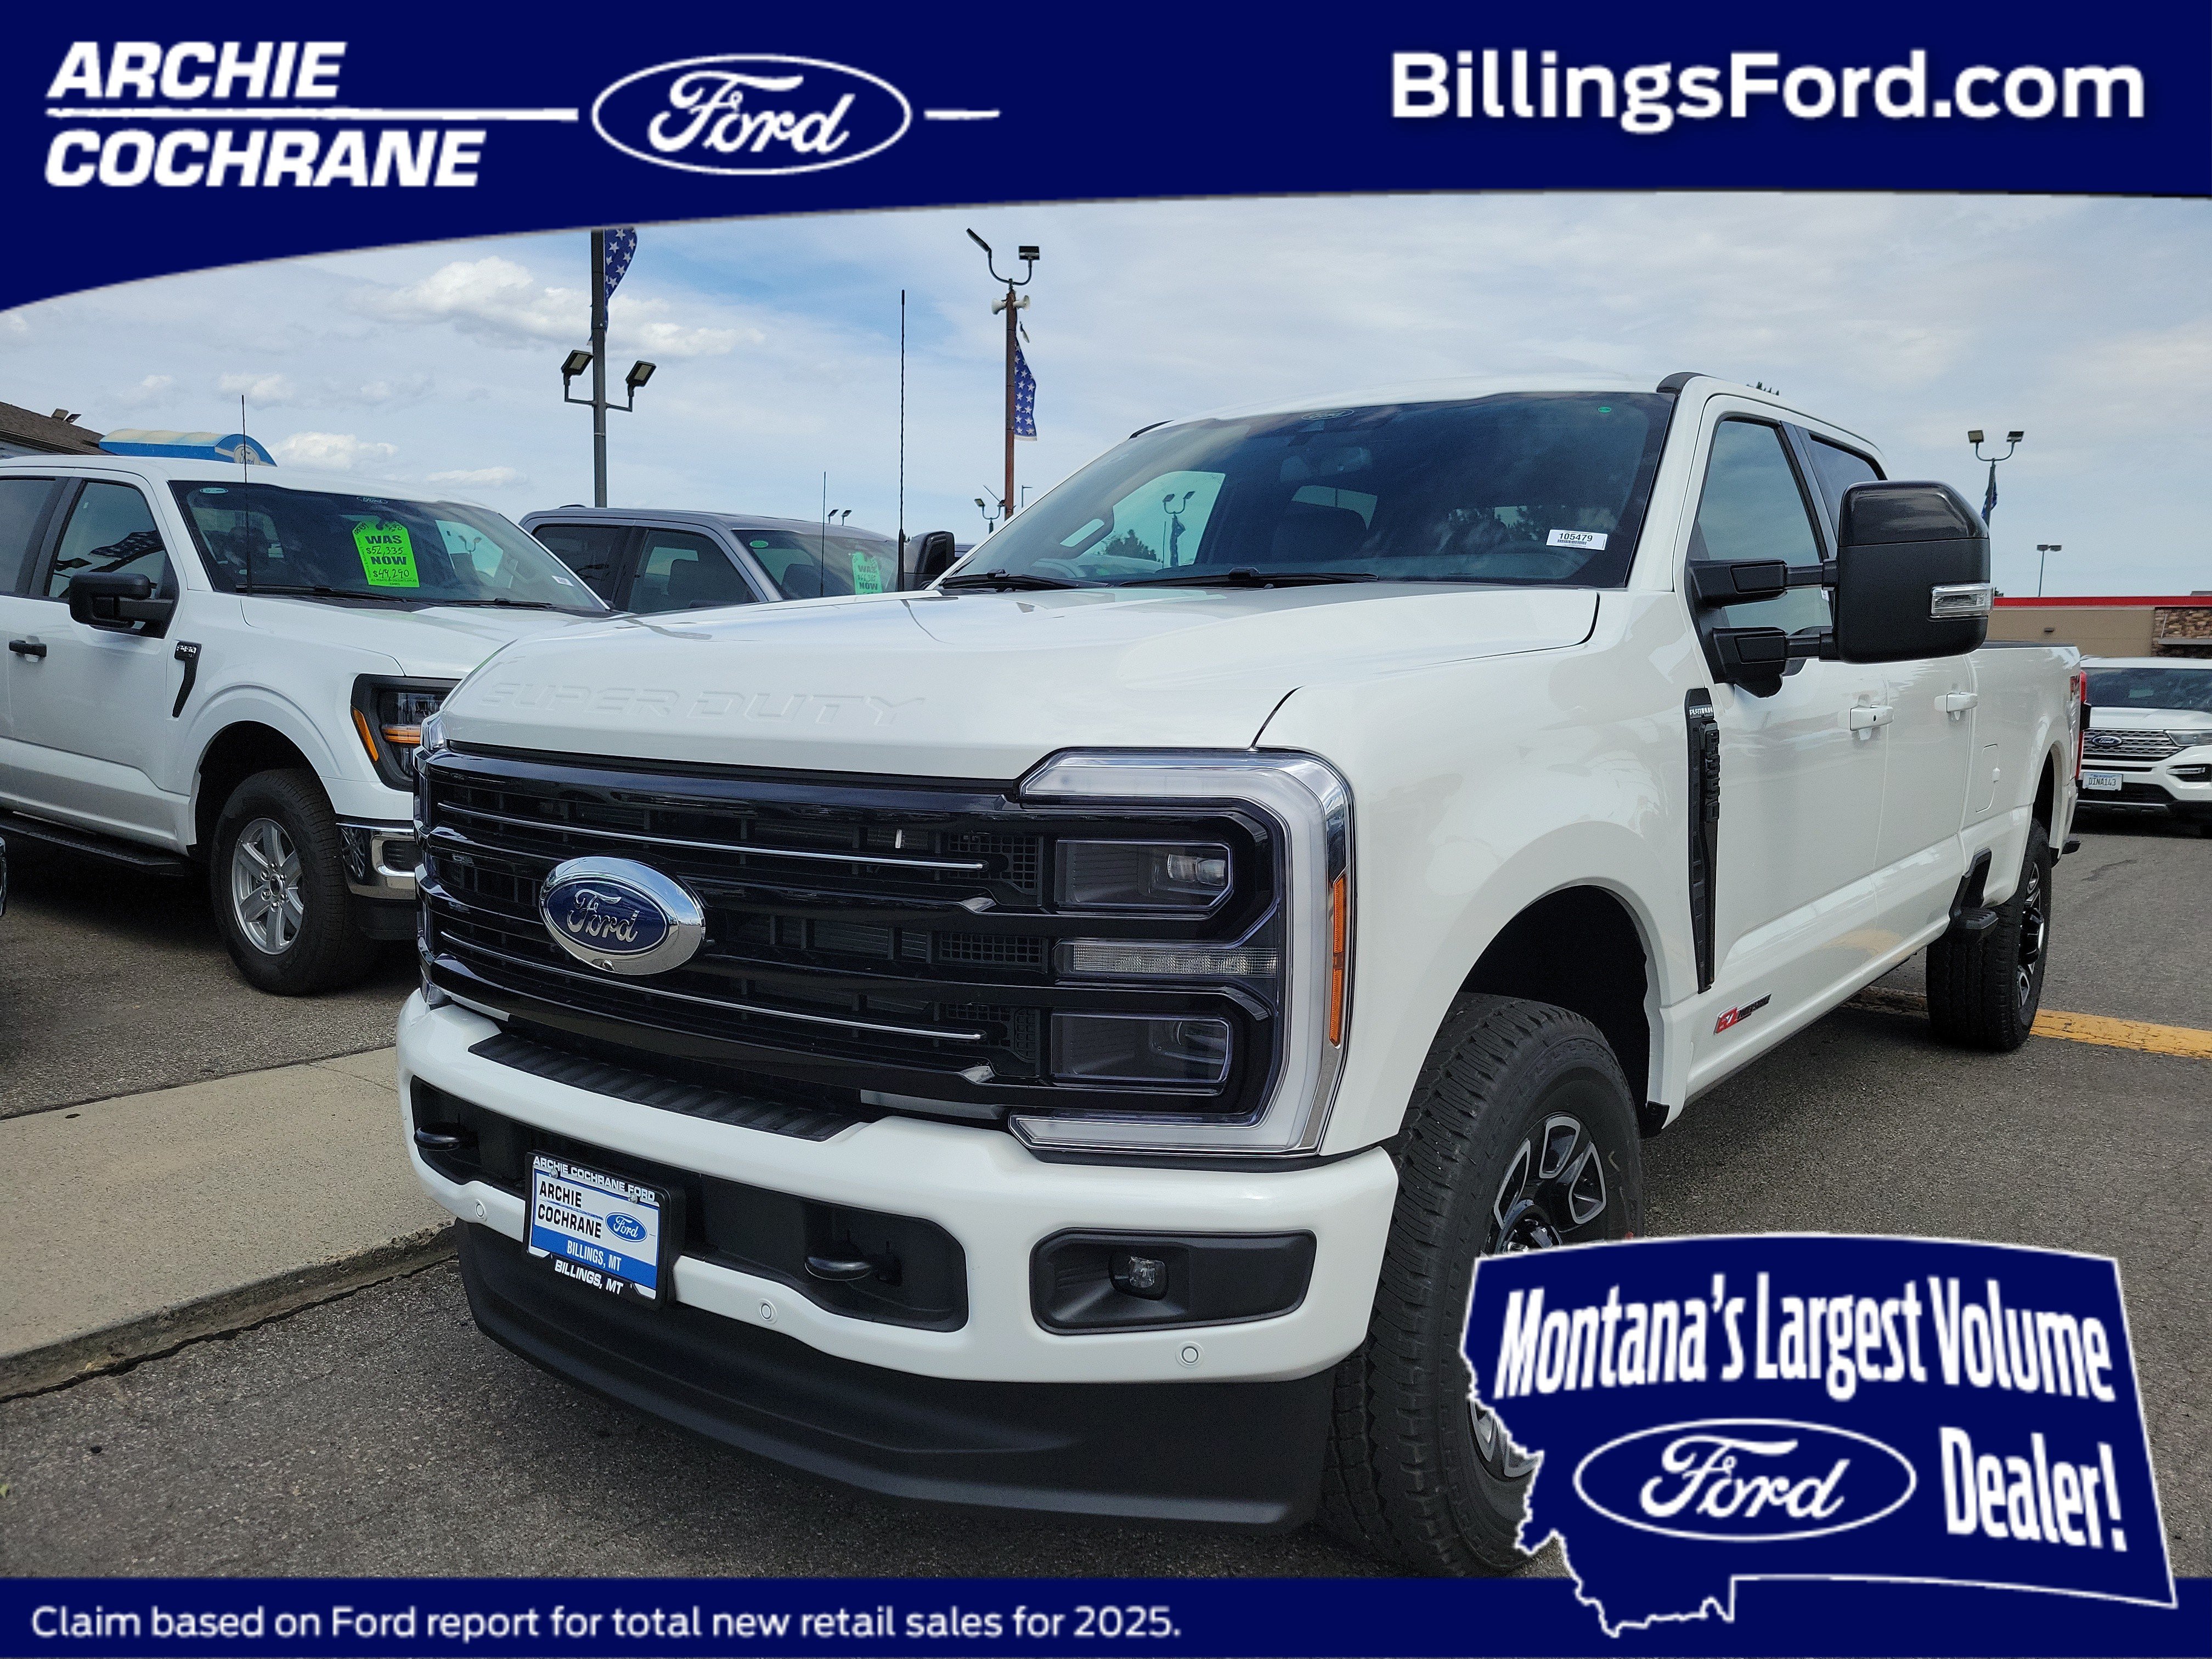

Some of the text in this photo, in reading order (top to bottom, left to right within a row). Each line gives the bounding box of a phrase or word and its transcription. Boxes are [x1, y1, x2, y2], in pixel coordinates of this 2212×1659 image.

[364, 535, 403, 544] WAS
[1559, 533, 1593, 542] 105479
[366, 545, 404, 557] $52,335
[370, 556, 407, 565] NOW
[373, 568, 410, 580] $49,290
[859, 582, 878, 590] NOW
[479, 682, 927, 726] SUPER DUTY
[567, 888, 641, 943] Ford
[533, 1156, 656, 1202] ARCHIE COCHRANE FORD
[539, 1181, 583, 1209] ARCHIE
[538, 1204, 602, 1239] COCHRANE
[613, 1216, 639, 1238] Ford
[567, 1240, 622, 1272] BILLINGS, MT
[554, 1259, 624, 1295] BILLINGS, MT
